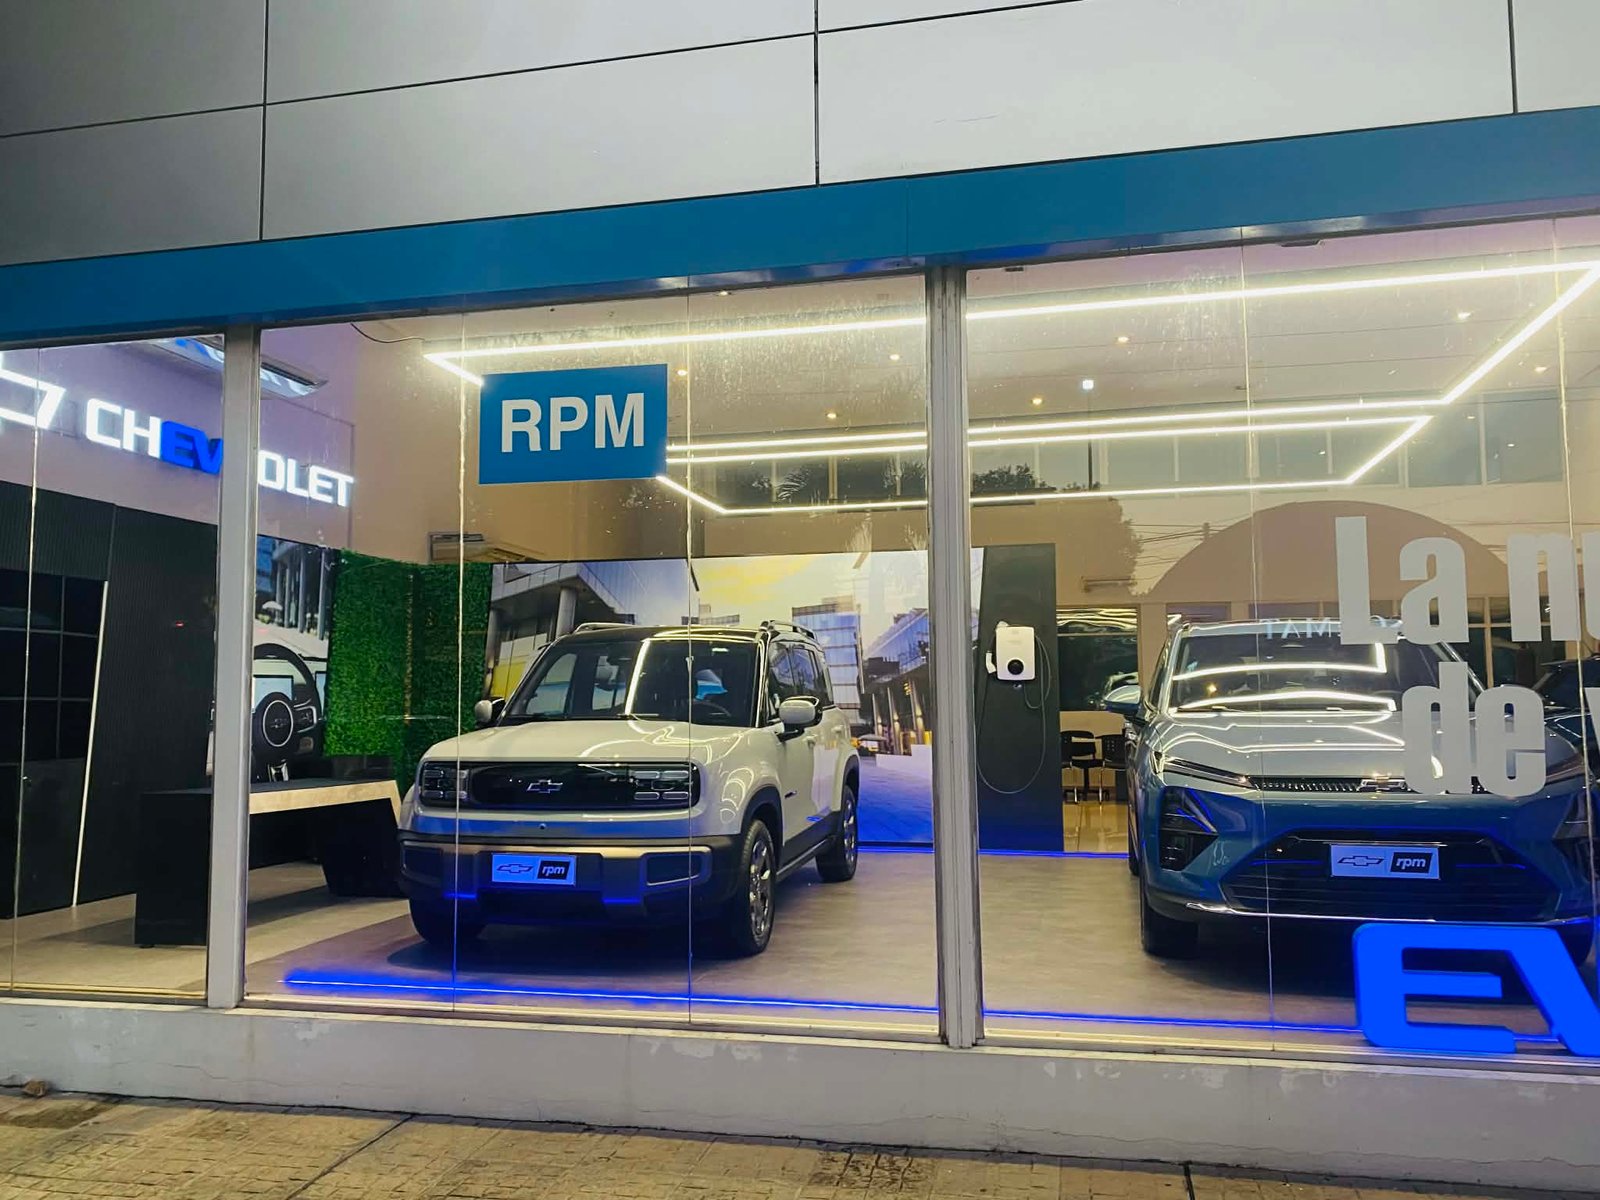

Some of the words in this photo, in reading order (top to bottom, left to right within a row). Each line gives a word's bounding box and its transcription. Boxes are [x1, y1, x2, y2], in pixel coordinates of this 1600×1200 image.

[86, 398, 354, 508] CHEVOLET
[501, 392, 645, 453] RPM
[1335, 516, 1469, 645] La
[1506, 531, 1600, 641] n
[1402, 661, 1547, 797] de
[541, 865, 566, 877] rpm
[1396, 857, 1427, 870] rpm
